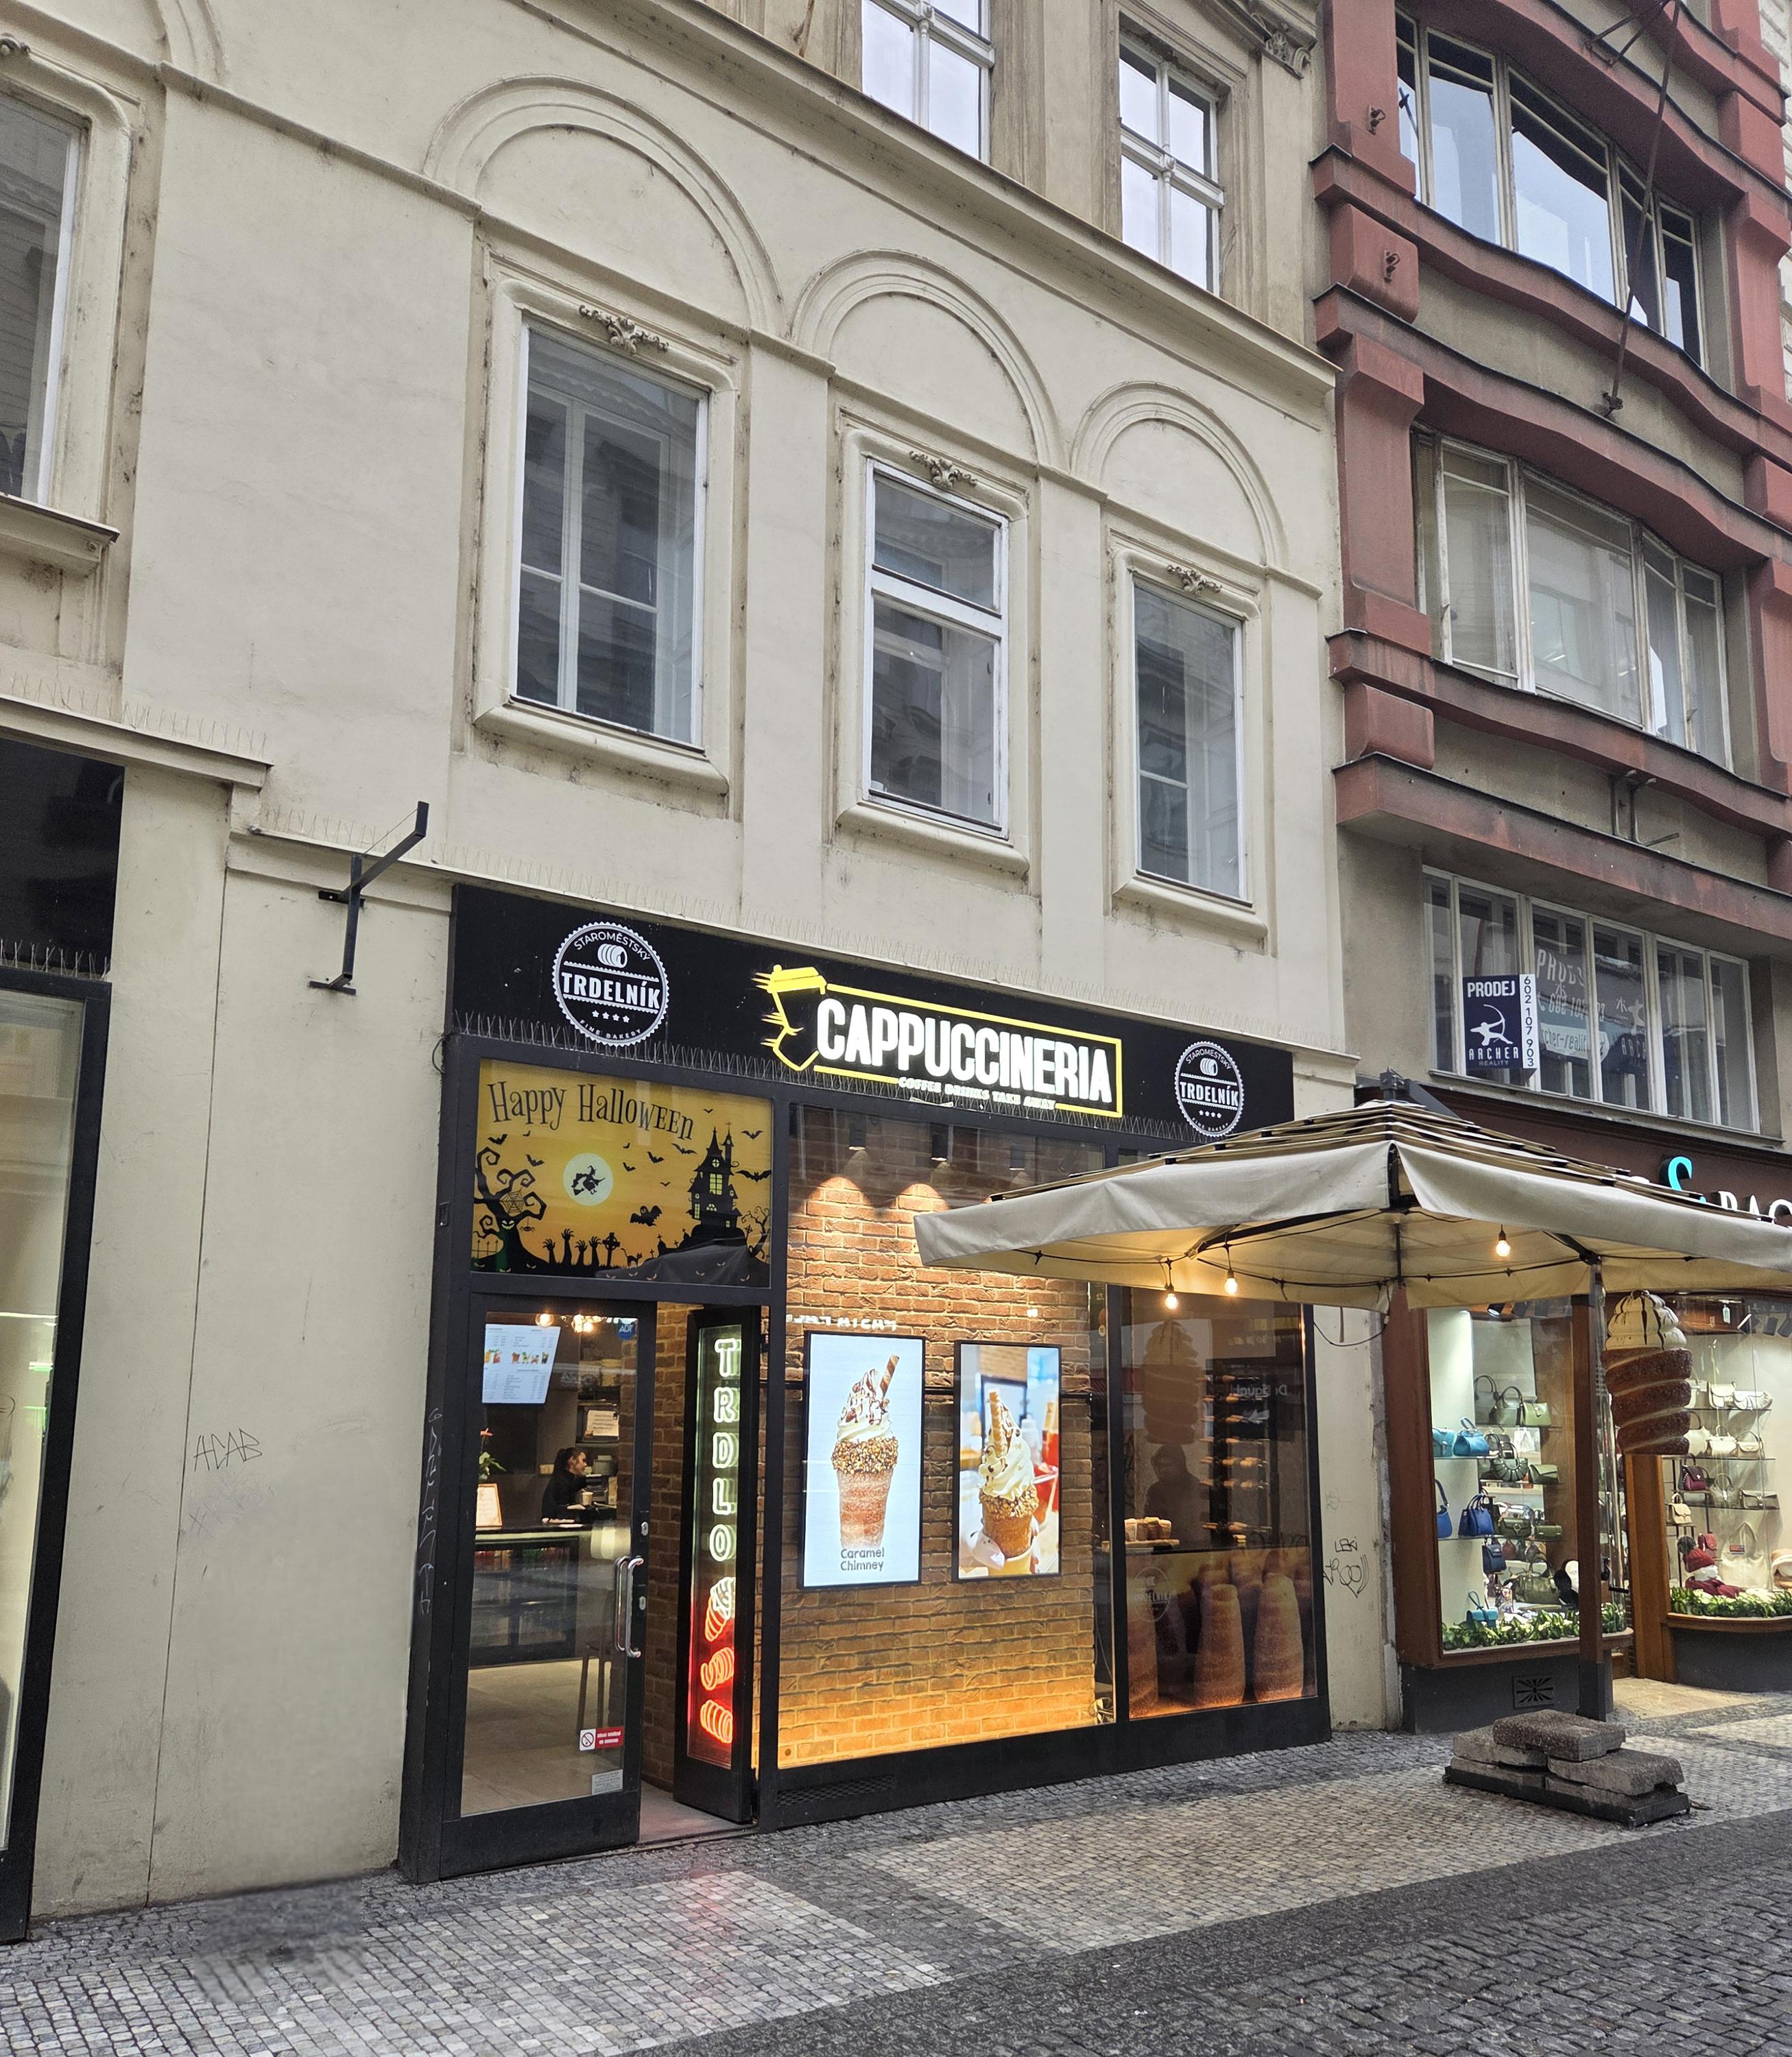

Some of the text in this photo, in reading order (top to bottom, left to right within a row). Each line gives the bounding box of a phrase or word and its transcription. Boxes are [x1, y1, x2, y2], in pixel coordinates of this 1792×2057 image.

[561, 972, 660, 1009] TRDELNÍK
[1467, 981, 1516, 998] PRODEJ
[580, 1020, 642, 1039] FINE BAKERY
[816, 998, 1112, 1103] CAPPUCCINERIA
[1469, 1046, 1519, 1060] ARCHER
[898, 1076, 942, 1093] COFFEE
[1180, 1081, 1239, 1106] TRDELNÍK
[487, 1081, 567, 1131] Happy
[618, 1324, 634, 1334] ADT
[709, 1338, 740, 1563] TRDLO
[840, 1547, 885, 1559] Caramel
[840, 1560, 884, 1572] Chimney
